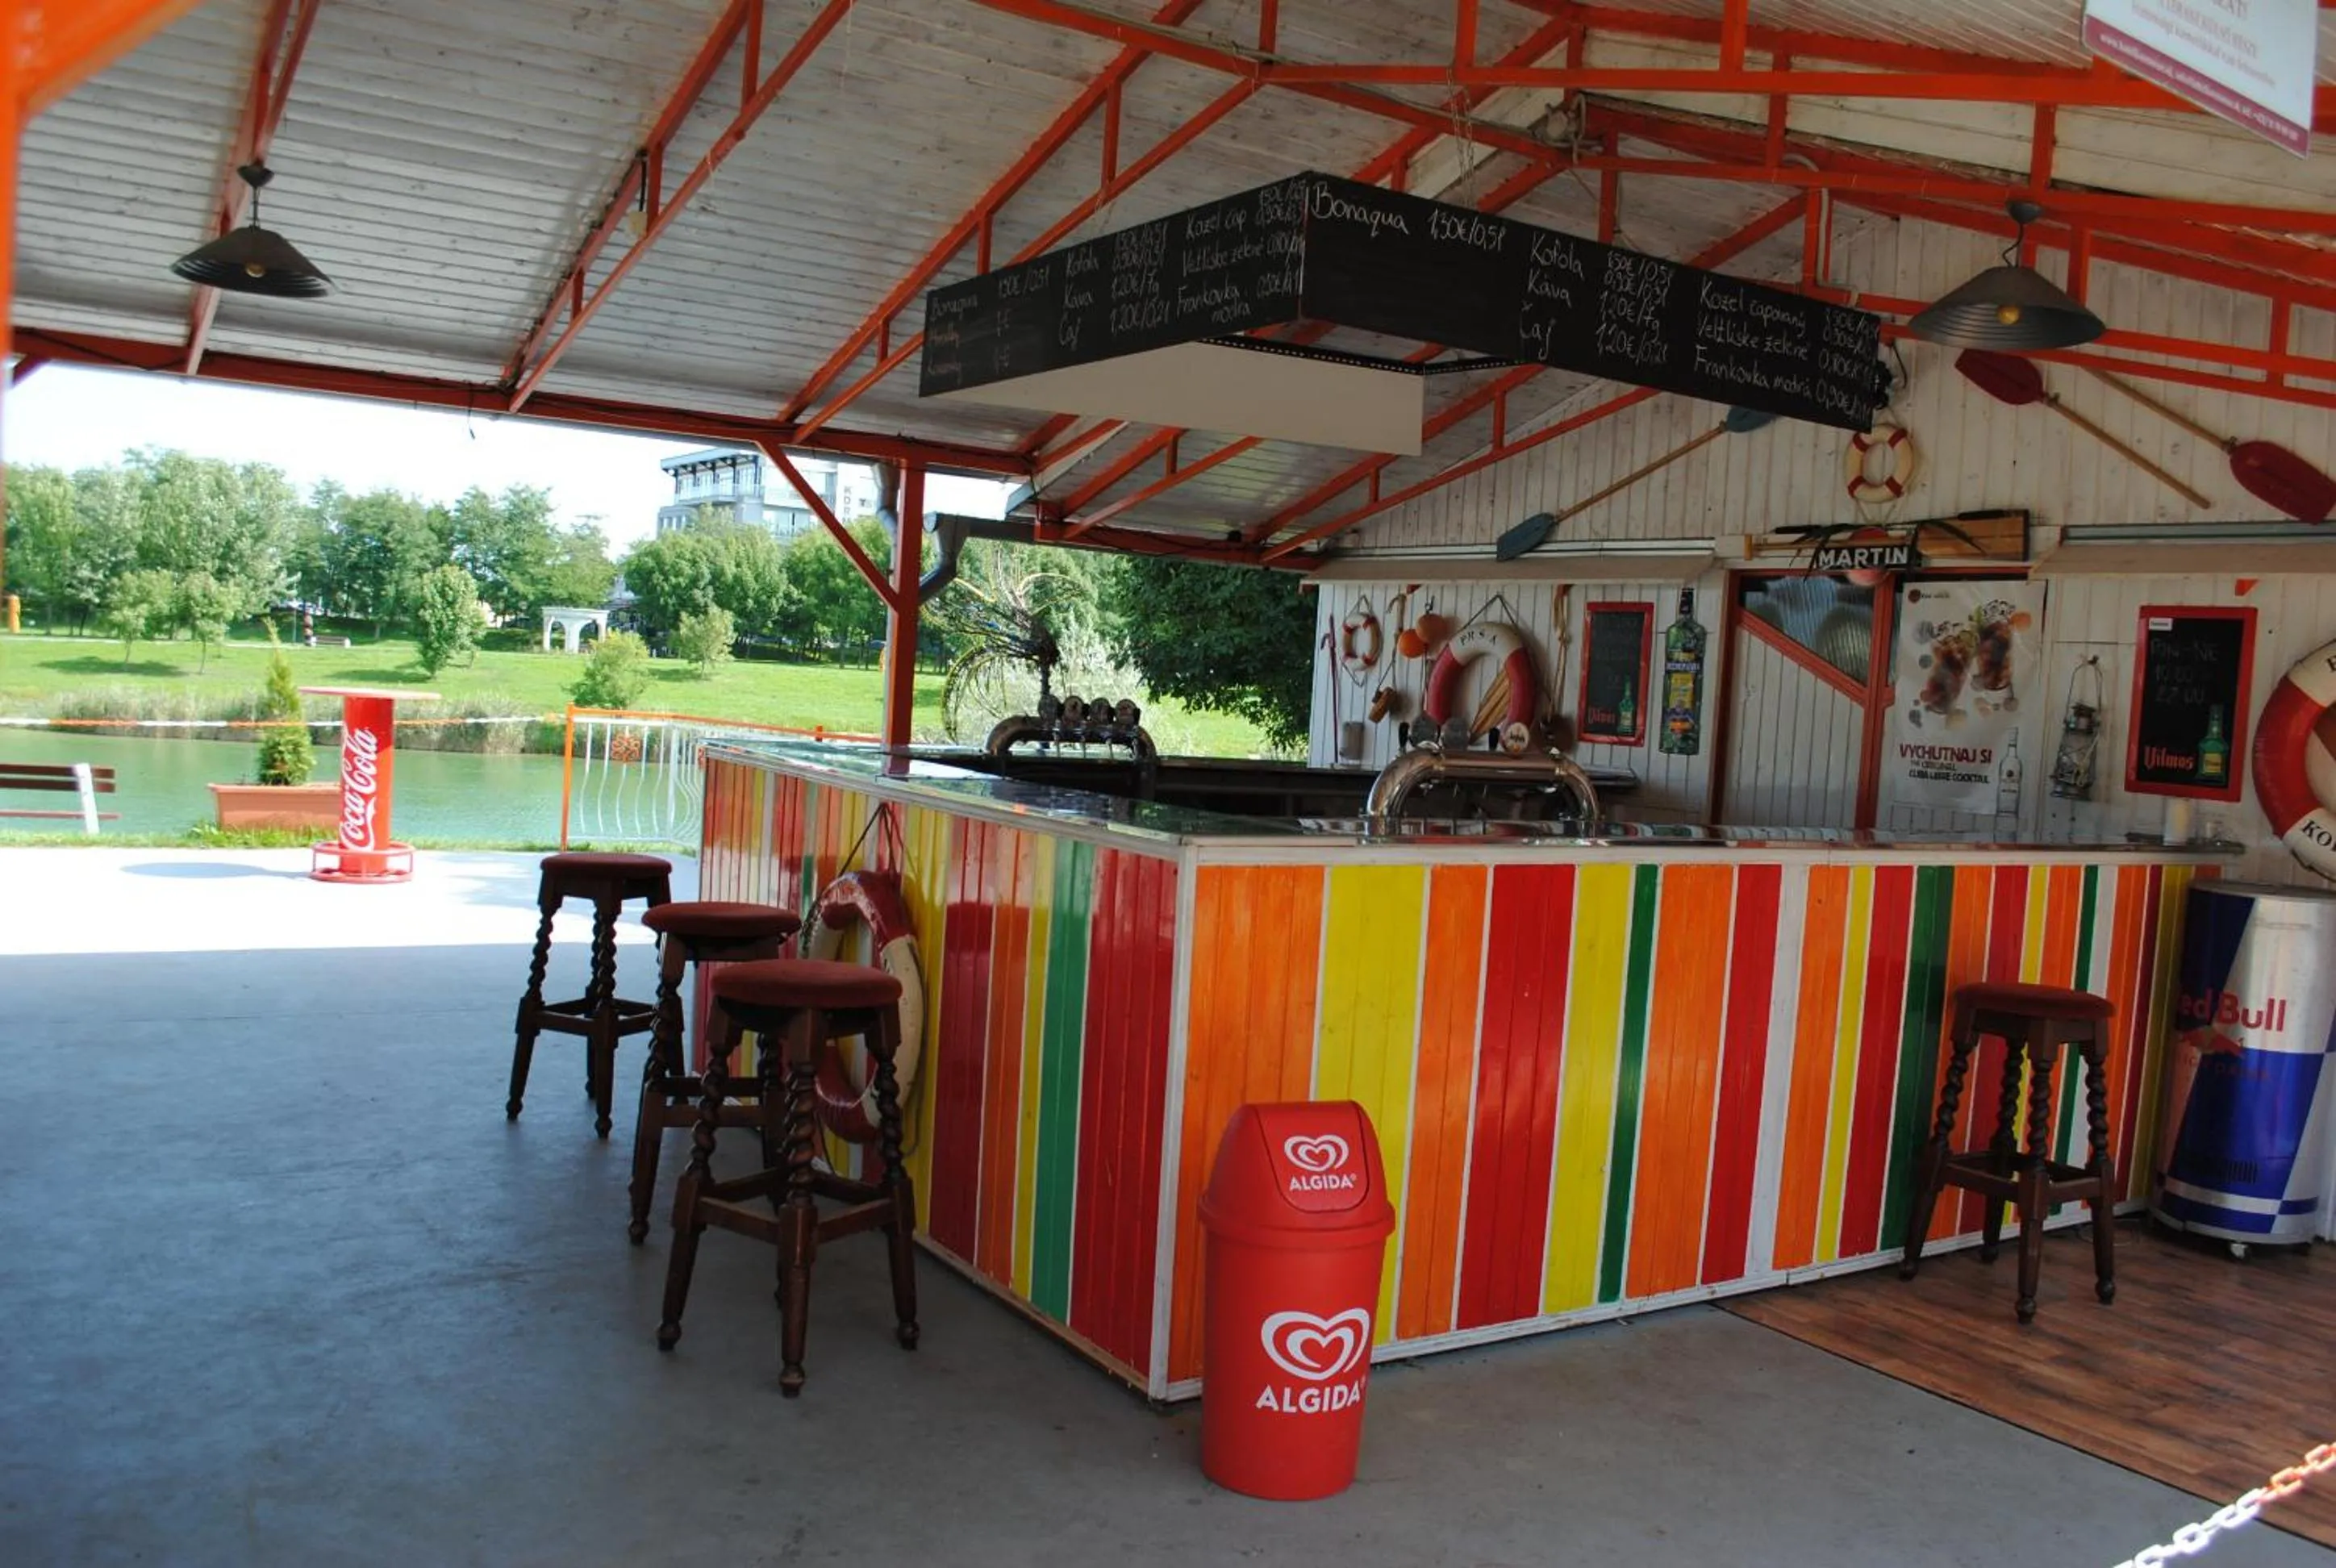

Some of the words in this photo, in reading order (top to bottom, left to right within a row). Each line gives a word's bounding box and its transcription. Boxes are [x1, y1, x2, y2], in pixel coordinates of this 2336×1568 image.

[1310, 181, 1410, 238] Bonaqua
[1531, 230, 1584, 281] Kofola
[1700, 274, 1744, 312] Kozel
[1818, 547, 1908, 568] MARTIN
[1900, 743, 1976, 763] VYCHUTNAJ
[1979, 749, 1992, 764] SI
[2144, 746, 2193, 771] Vilmos
[340, 724, 378, 852] Coca-Cola
[2217, 990, 2286, 1032] Bull
[1289, 1174, 1354, 1191] ALGIDA
[1255, 1380, 1362, 1414] ALGIDA
